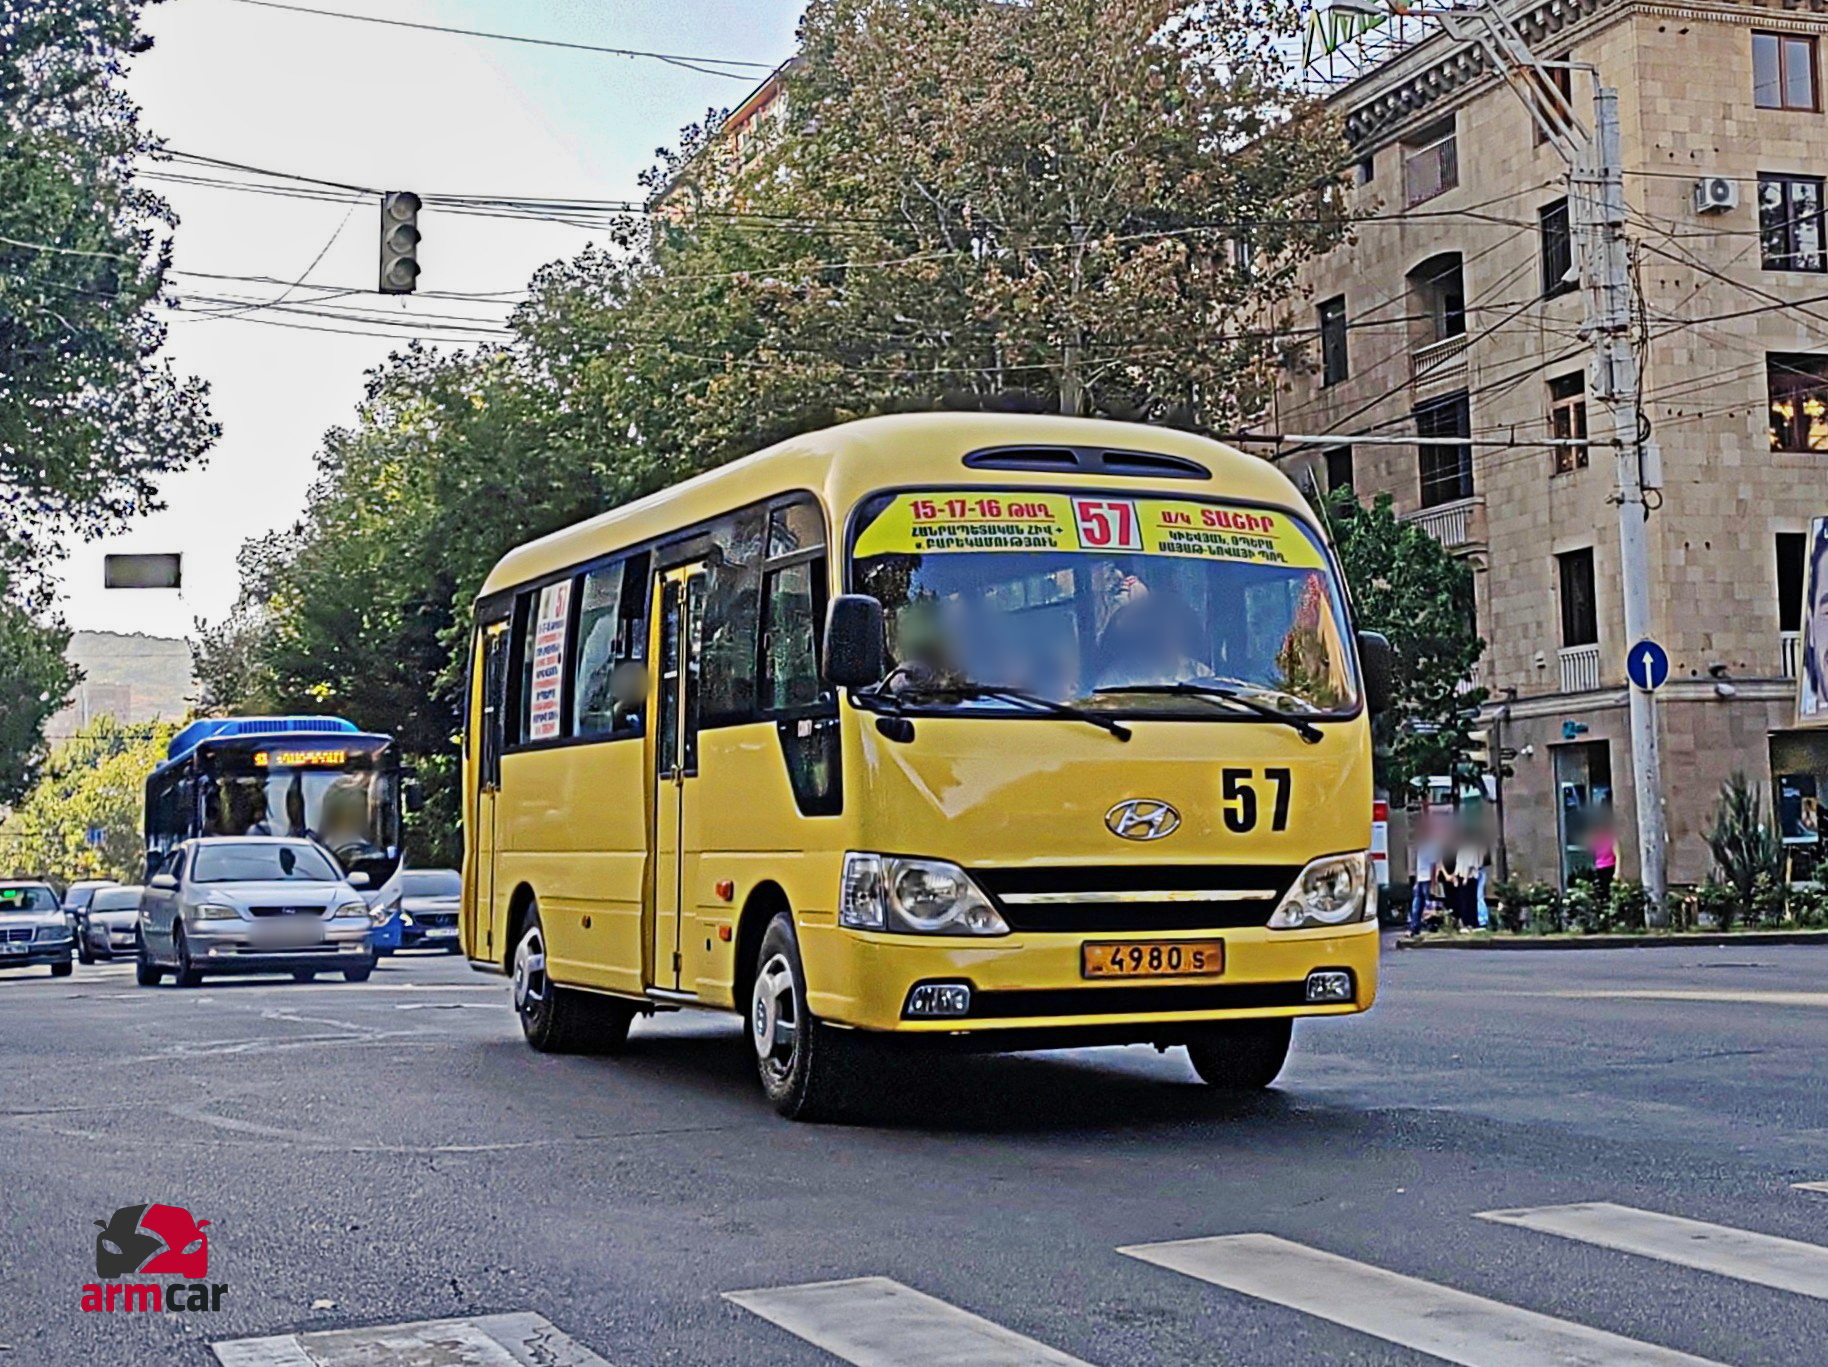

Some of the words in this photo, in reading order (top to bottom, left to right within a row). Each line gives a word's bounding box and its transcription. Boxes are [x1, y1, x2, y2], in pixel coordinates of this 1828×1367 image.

[909, 499, 1002, 519] 15-17-16
[1200, 509, 1275, 533] ՏԱՇԻՐ
[911, 524, 1024, 537] ՀԱՆՐԱՊԵՏԱԿԱՆ
[1079, 501, 1133, 547] 57
[1231, 537, 1274, 550] ՕՊԵՐԱ
[1222, 768, 1291, 833] 57
[1110, 946, 1182, 972] 4980
